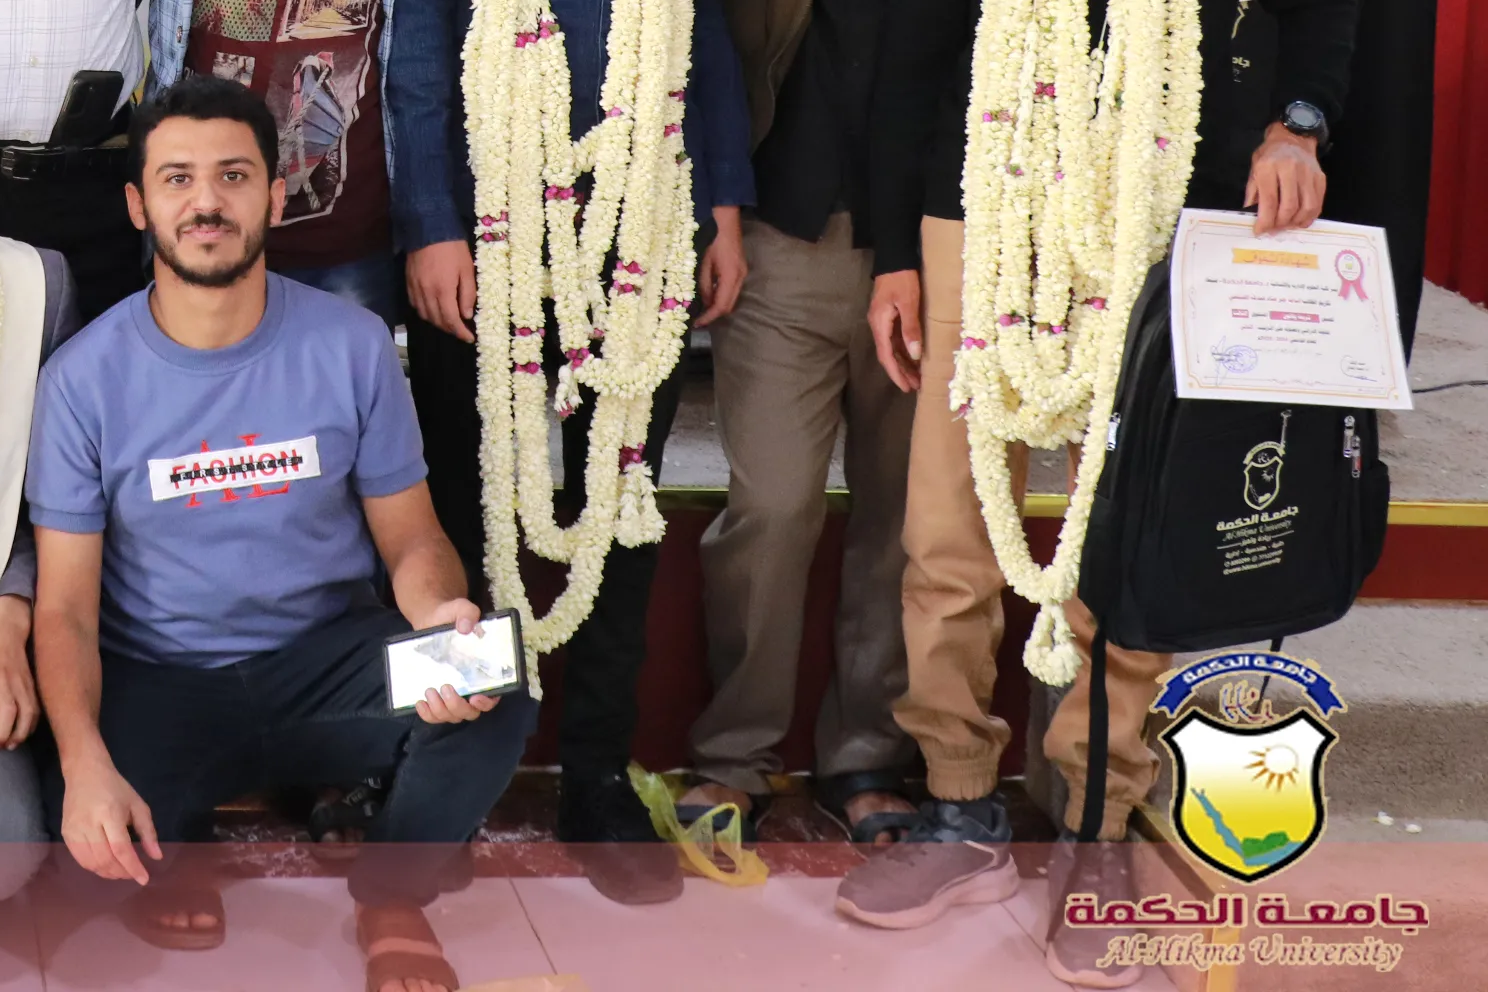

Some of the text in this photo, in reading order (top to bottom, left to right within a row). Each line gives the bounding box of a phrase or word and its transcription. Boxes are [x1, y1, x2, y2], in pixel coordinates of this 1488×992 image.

[171, 448, 302, 490] FASHION
[180, 458, 292, 481] FIRST STYLE
[1216, 506, 1299, 532] جامعة الحكمة
